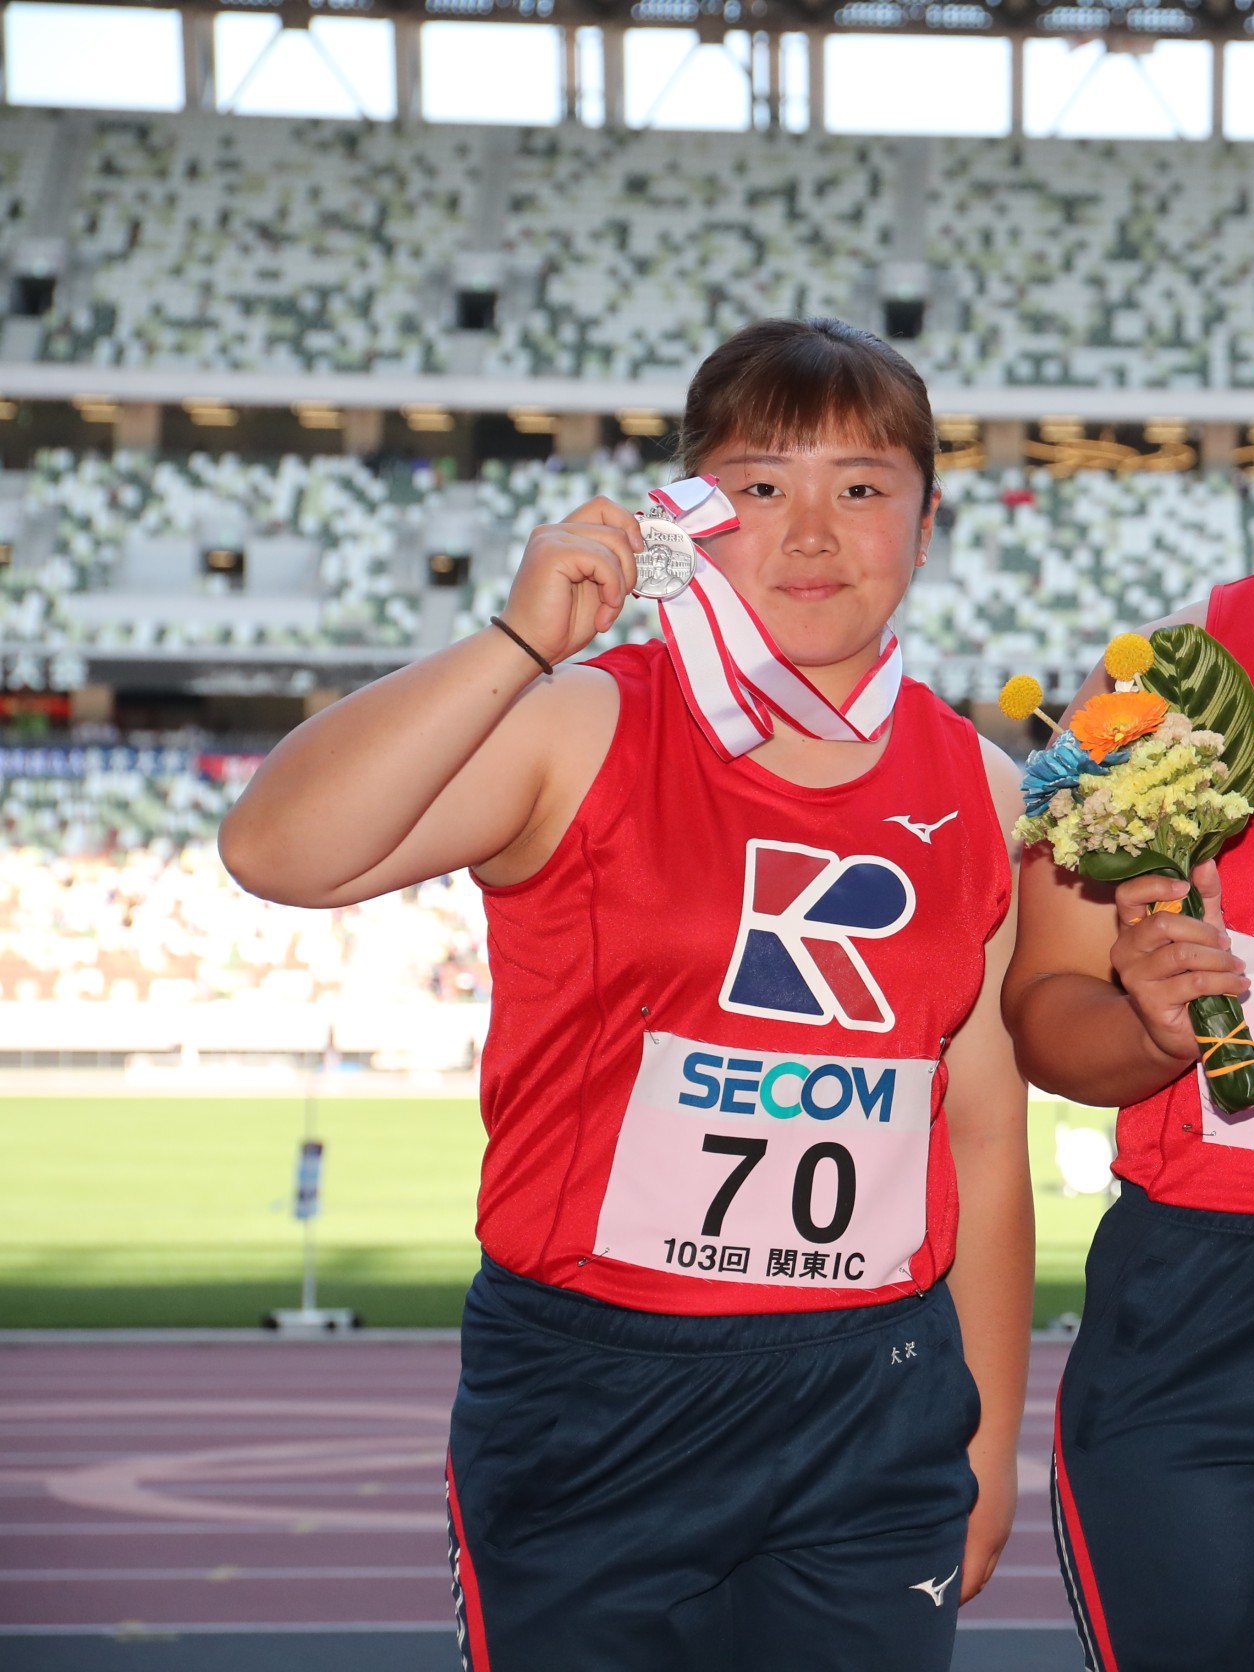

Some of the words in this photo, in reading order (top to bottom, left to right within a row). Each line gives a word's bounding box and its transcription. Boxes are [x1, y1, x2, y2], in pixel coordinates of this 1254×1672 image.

[678, 1051, 896, 1122] SECOM
[701, 1133, 856, 1244] 70
[663, 1238, 750, 1274] 103回
[766, 1248, 866, 1280] 関東IC
